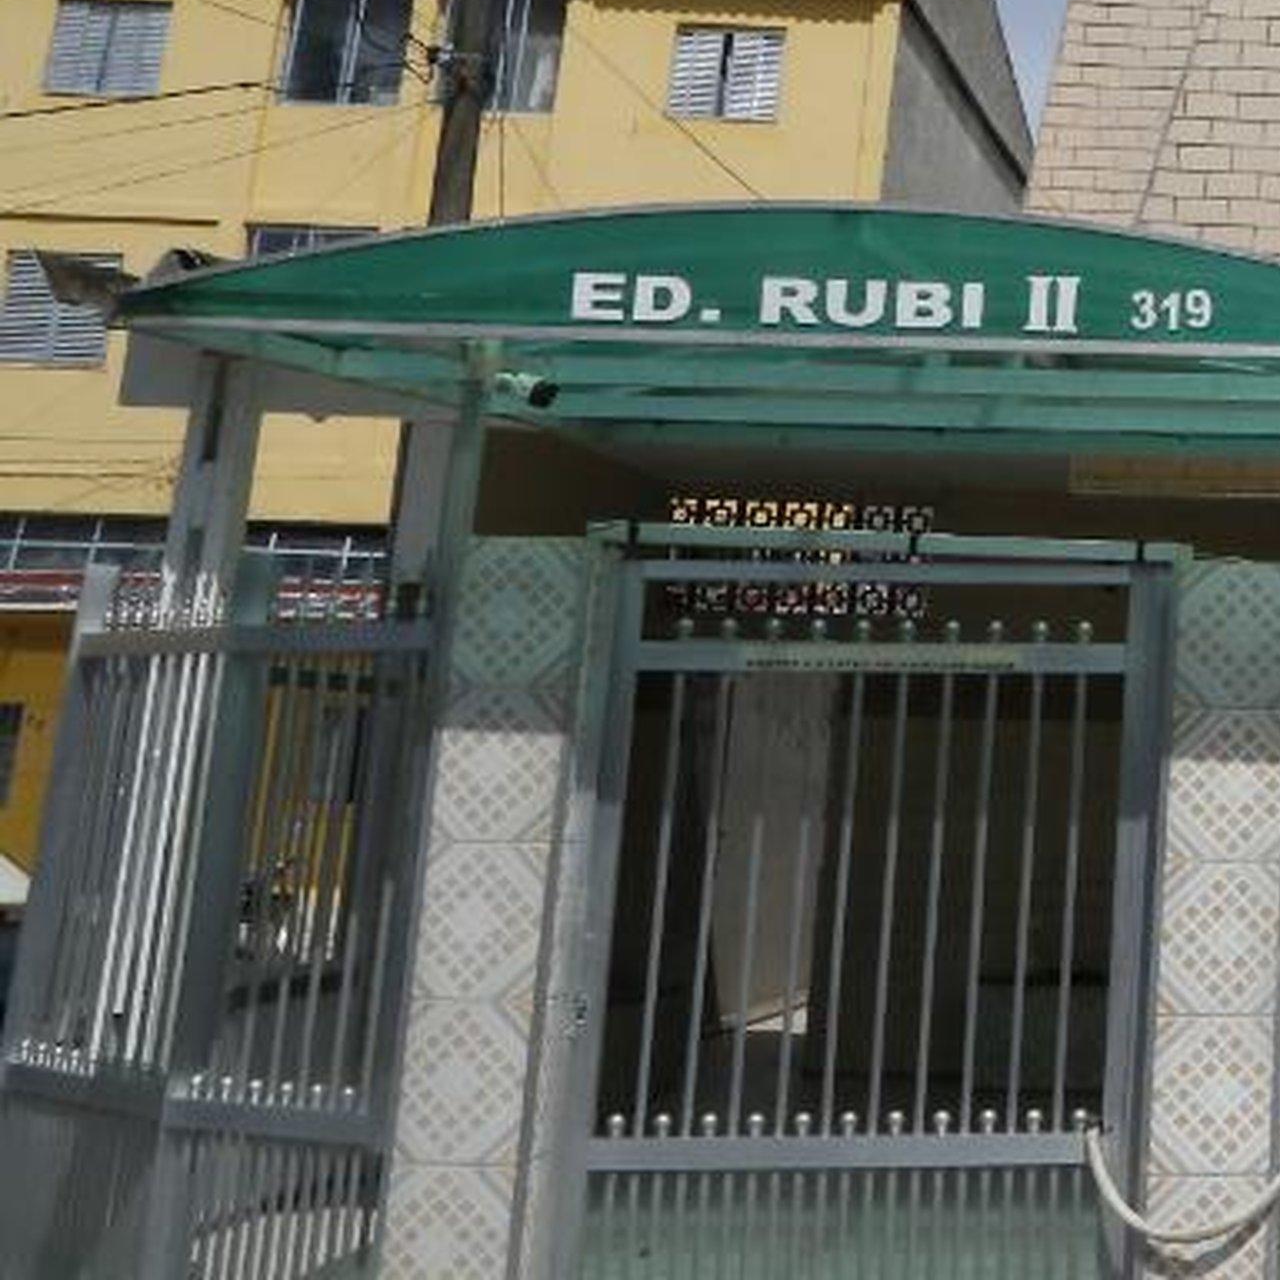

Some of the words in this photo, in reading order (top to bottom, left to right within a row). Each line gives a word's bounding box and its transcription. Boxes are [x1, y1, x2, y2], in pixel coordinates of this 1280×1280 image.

[571, 272, 721, 322] ED.
[759, 275, 986, 329] RUBI
[1022, 275, 1082, 334] II
[1130, 289, 1214, 331] 319
